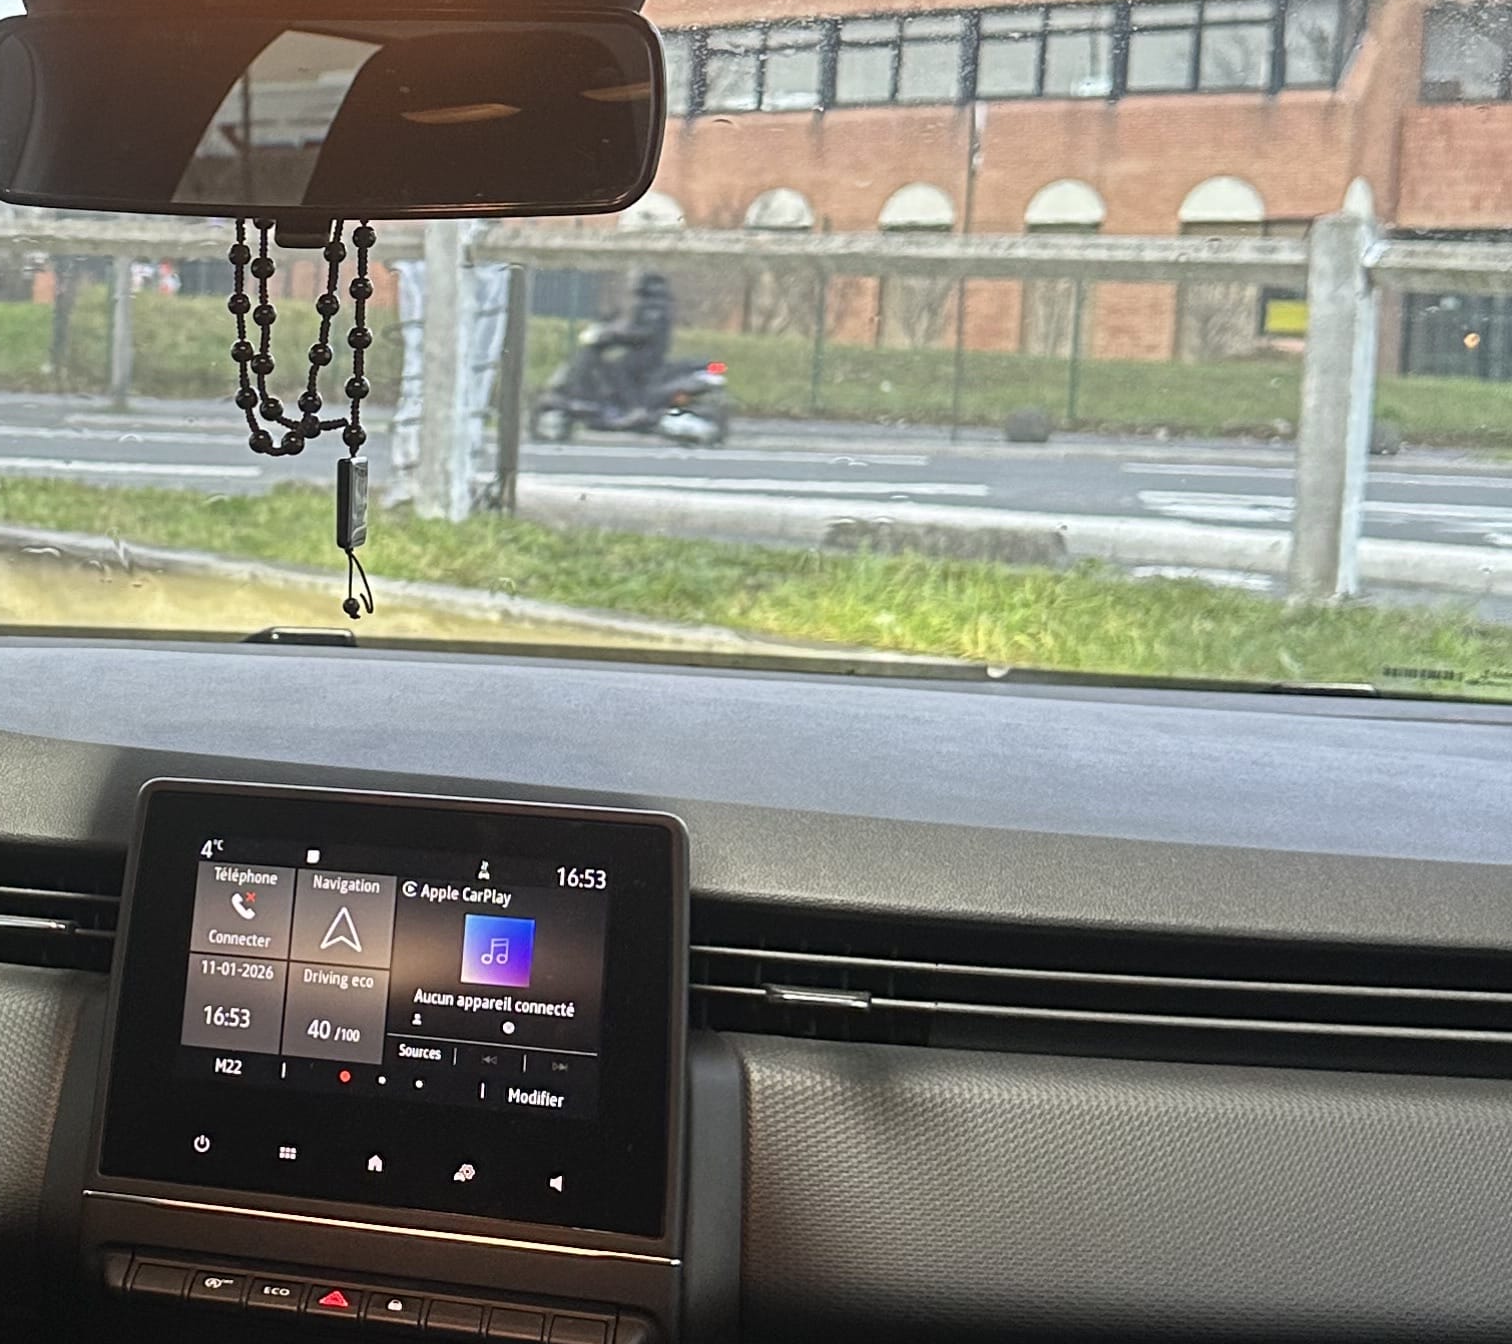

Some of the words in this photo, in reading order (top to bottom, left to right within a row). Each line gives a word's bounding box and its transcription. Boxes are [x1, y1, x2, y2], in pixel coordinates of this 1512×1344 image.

[214, 866, 278, 886] Téléphone
[313, 875, 380, 894] Navigation
[556, 866, 607, 889] 16:53
[420, 884, 460, 903] Apple
[462, 887, 512, 908] CarPlay
[209, 929, 271, 948] Connecter
[201, 960, 274, 980] 11-01-2026
[303, 969, 348, 989] Driving
[351, 977, 374, 988] eco
[414, 988, 454, 1006] Aucun
[456, 993, 512, 1012] appareil
[515, 999, 575, 1017] connecté
[204, 1006, 251, 1028] 16:53
[307, 1019, 331, 1039] 40
[334, 1027, 360, 1042] /100
[399, 1044, 441, 1060] Sources
[215, 1058, 242, 1075] M22
[508, 1088, 564, 1108] Modifier
[263, 1286, 290, 1296] ECO
